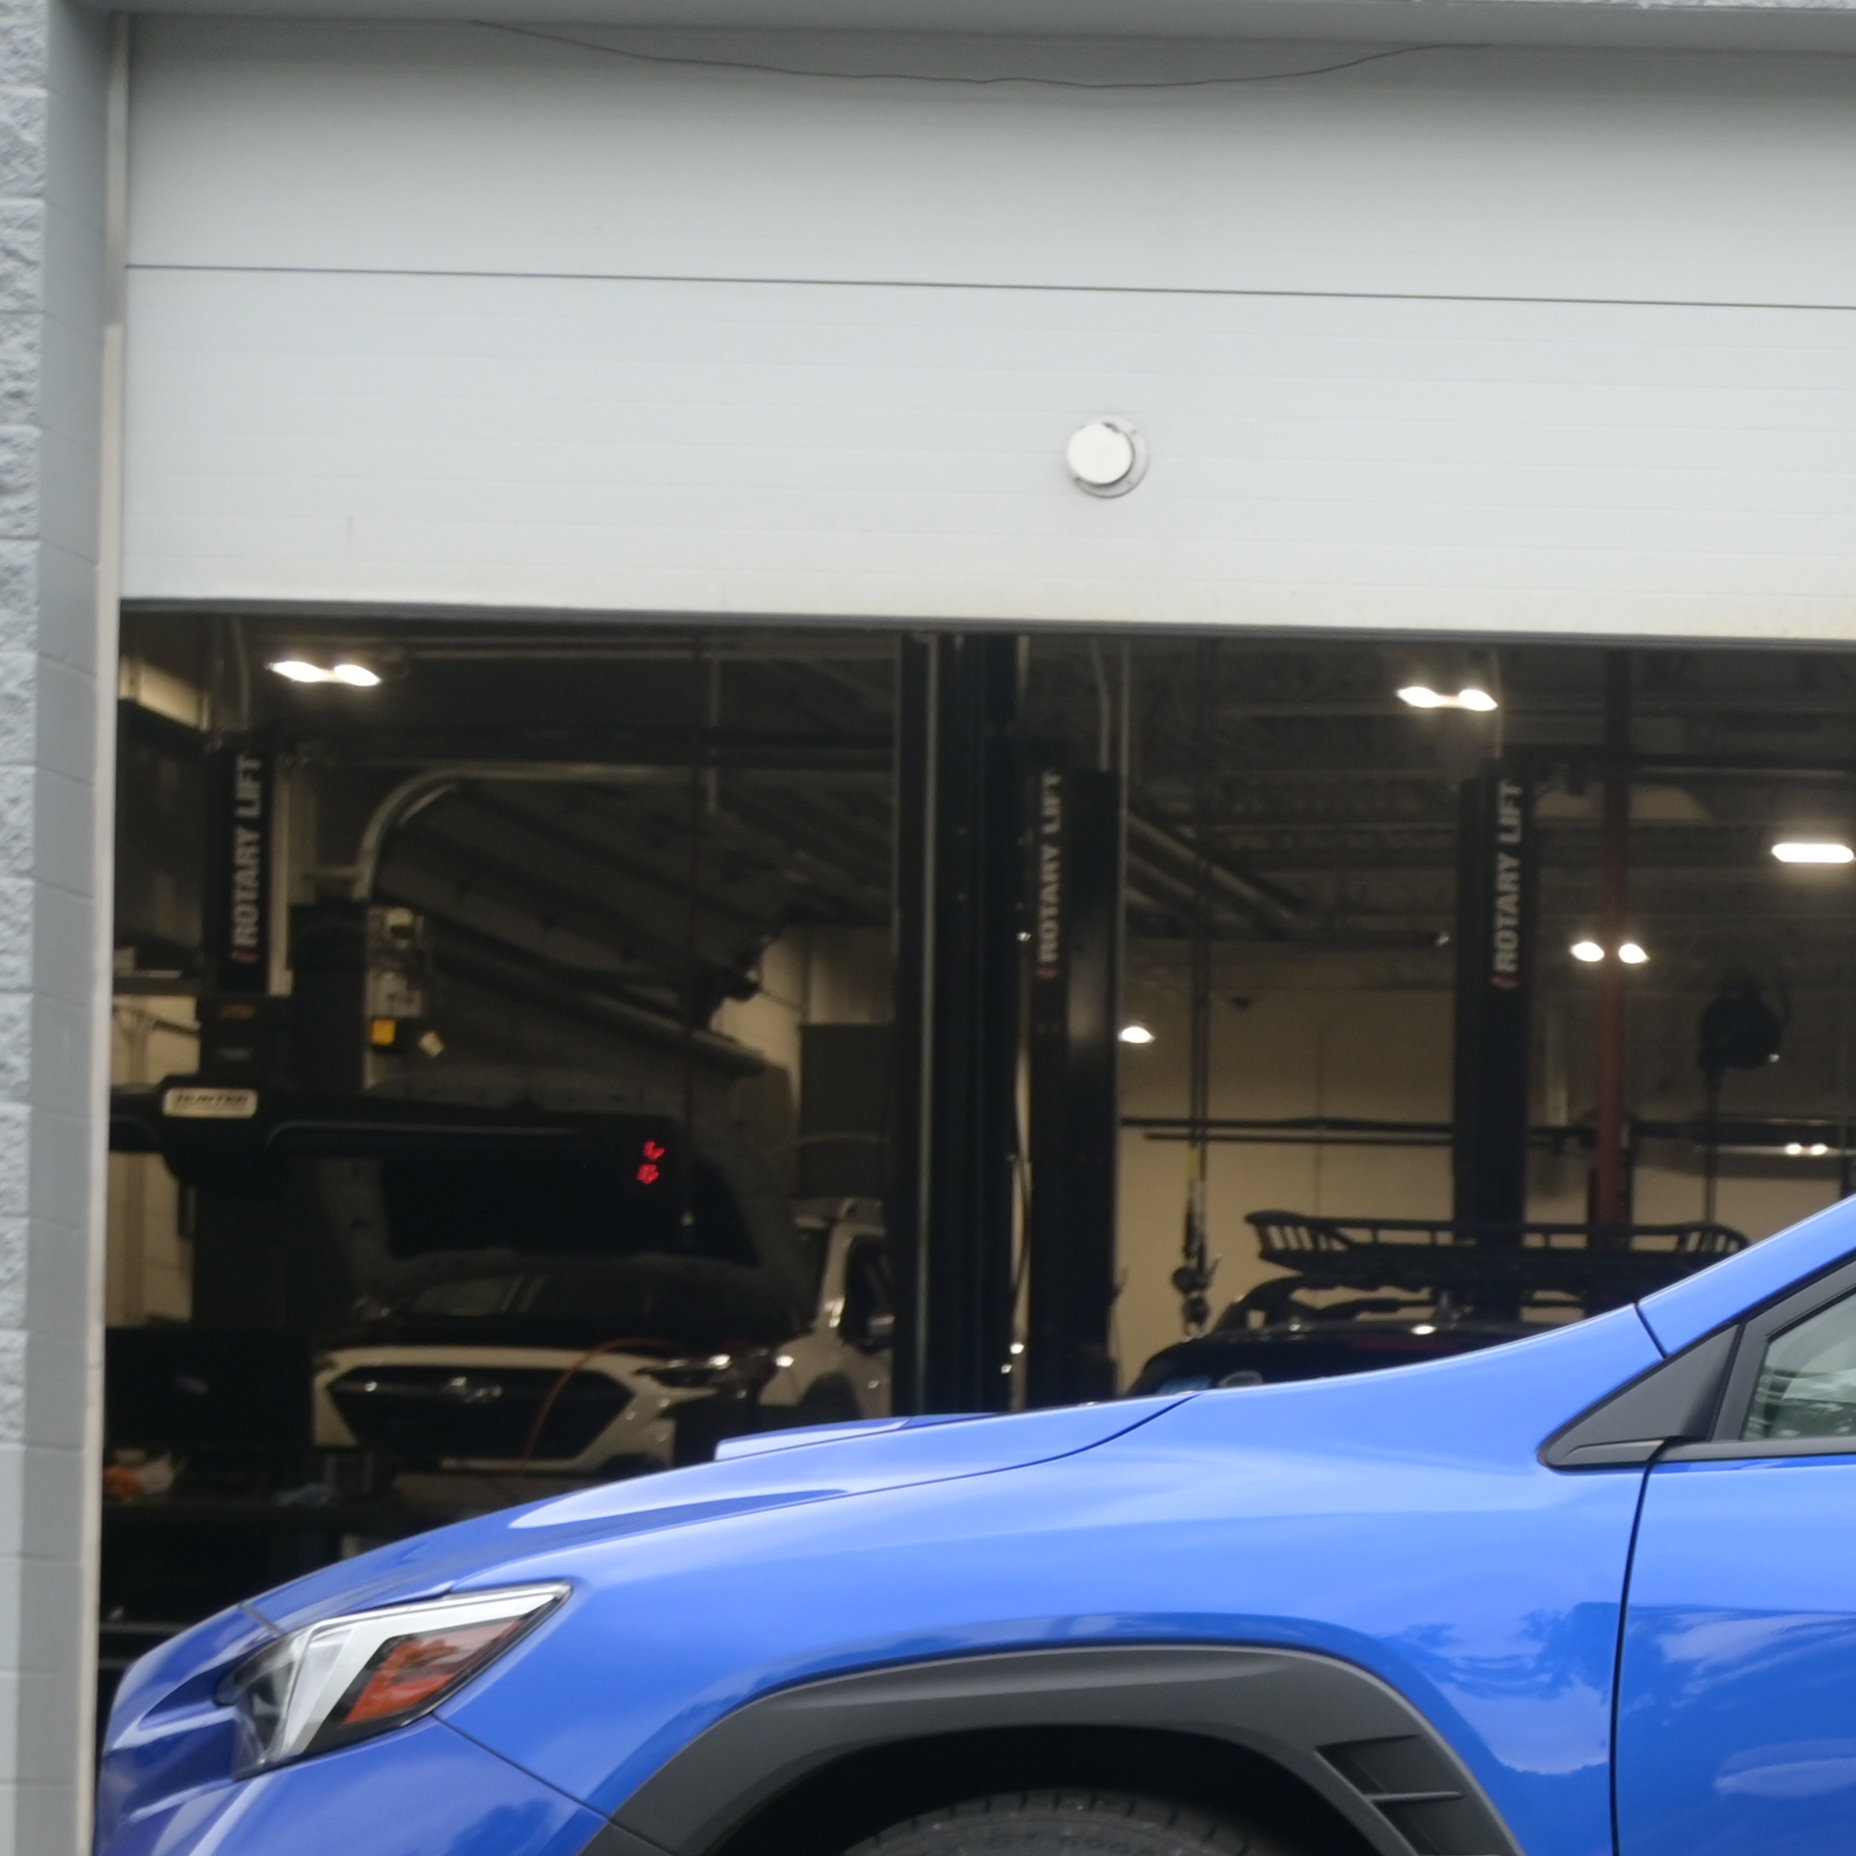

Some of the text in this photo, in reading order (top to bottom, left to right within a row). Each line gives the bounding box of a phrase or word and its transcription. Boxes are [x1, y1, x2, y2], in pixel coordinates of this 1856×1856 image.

[231, 754, 262, 947] ROTARY LIFT
[1038, 771, 1062, 963] ROTARY LIFT
[1493, 779, 1523, 973] ROTARY LIFT
